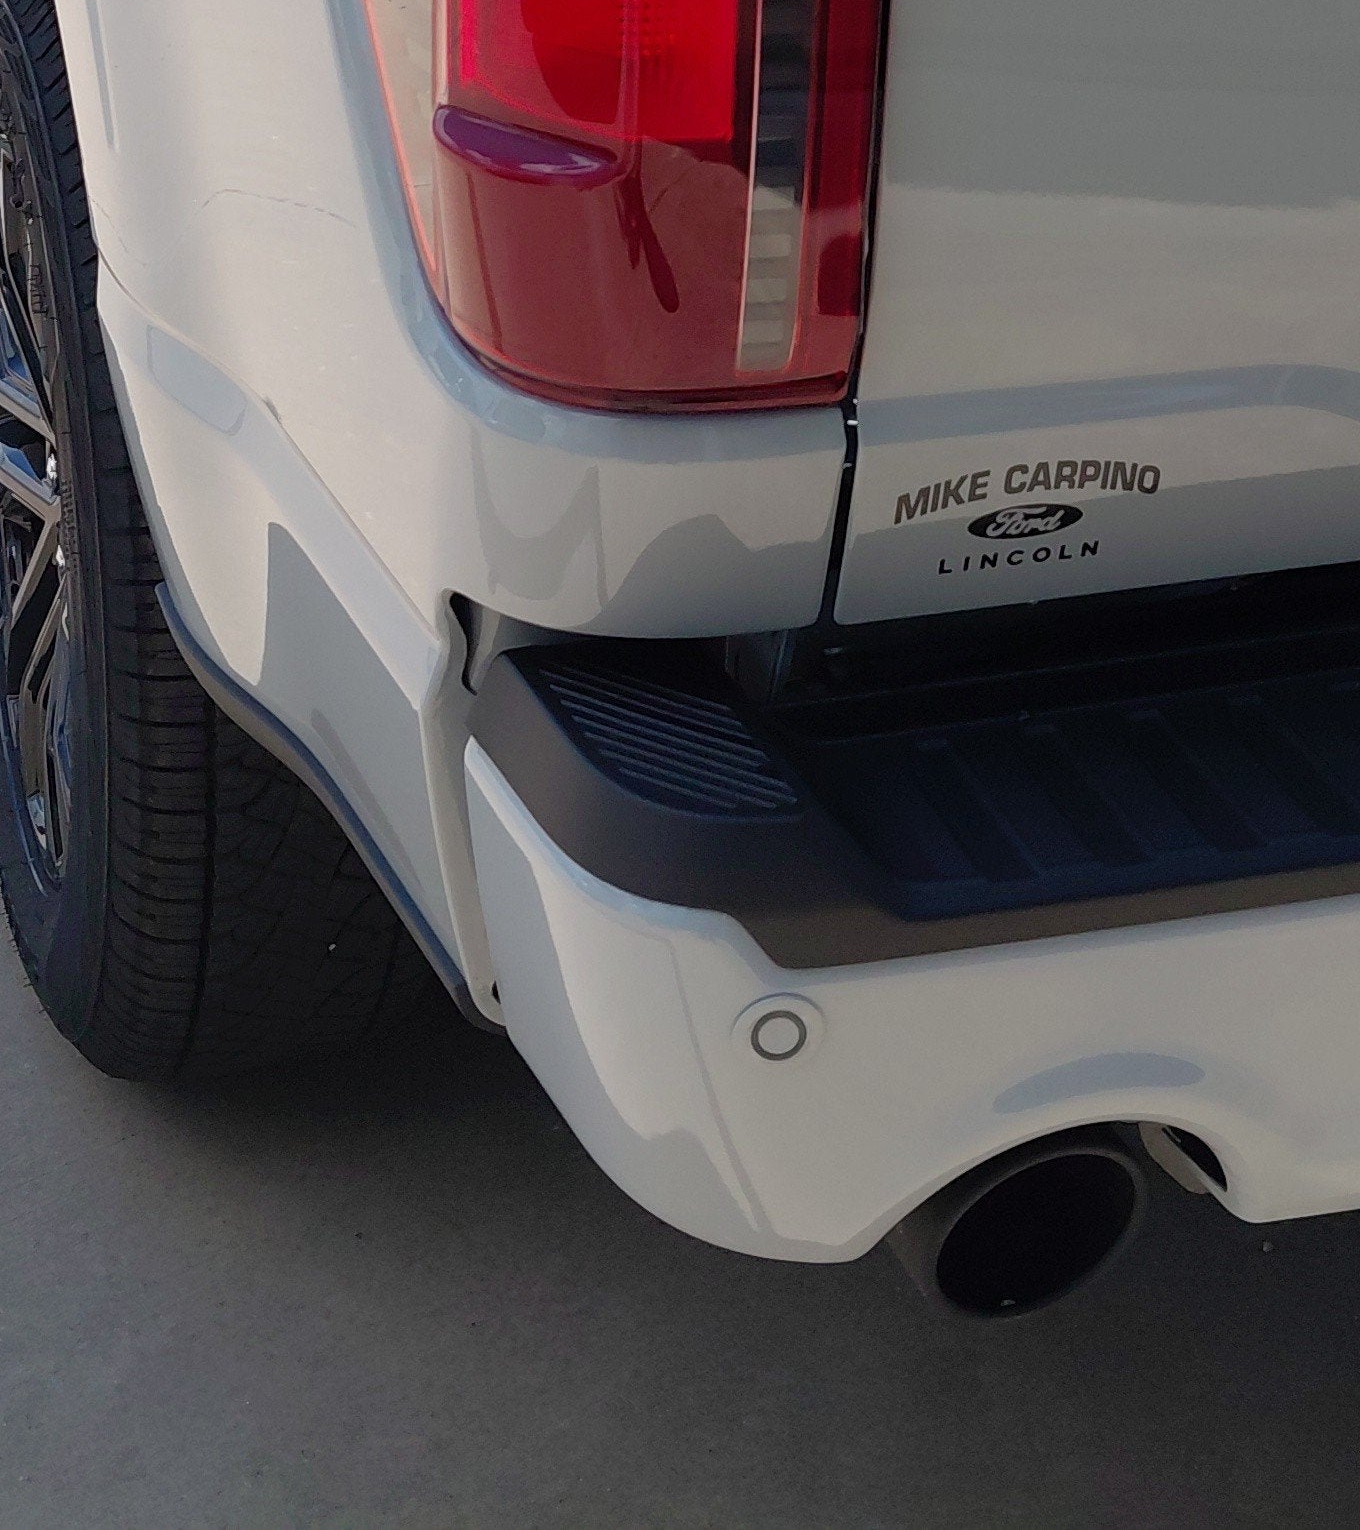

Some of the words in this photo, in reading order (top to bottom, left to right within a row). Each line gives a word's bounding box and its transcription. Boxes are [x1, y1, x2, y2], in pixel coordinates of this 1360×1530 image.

[893, 470, 991, 525] MIKE
[1004, 459, 1162, 495] CARPINO
[985, 506, 1065, 538] Ford
[938, 540, 1100, 575] LINCOLN
